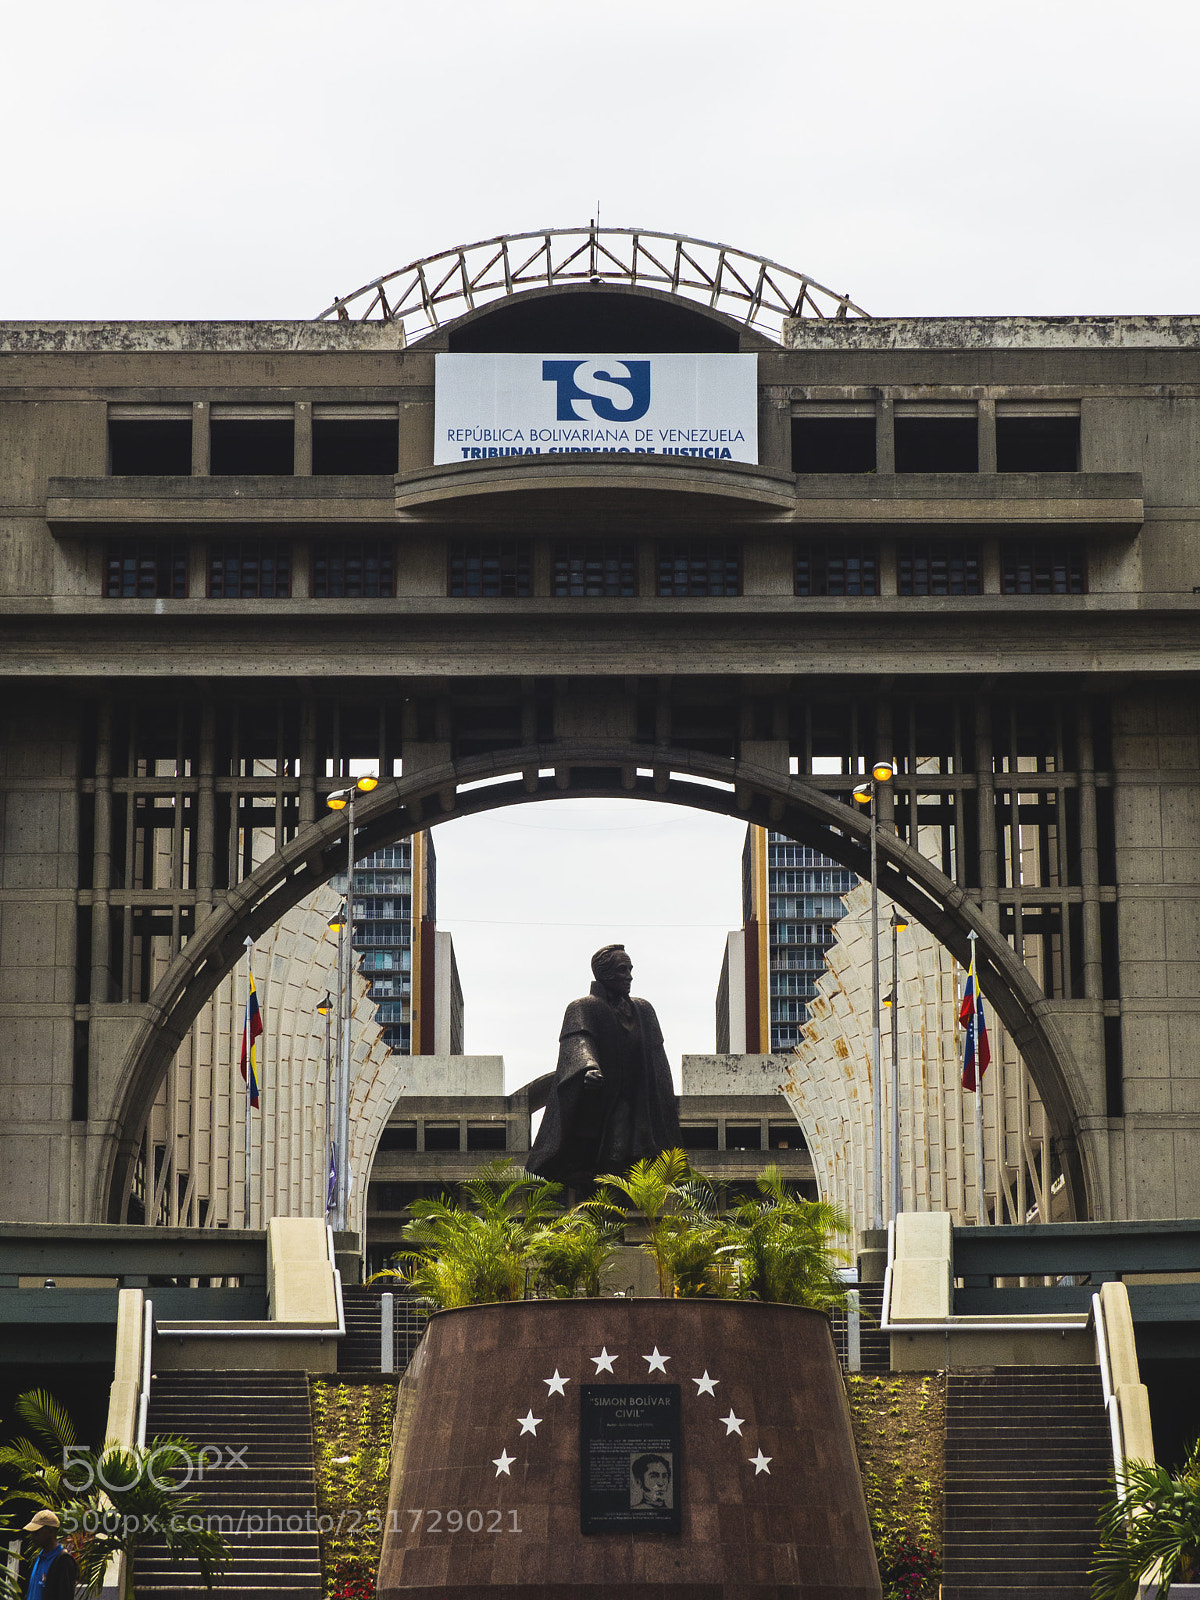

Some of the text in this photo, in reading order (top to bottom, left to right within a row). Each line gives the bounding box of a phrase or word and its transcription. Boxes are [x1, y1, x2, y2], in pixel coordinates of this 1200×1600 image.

[542, 360, 650, 422] TSJ
[447, 425, 745, 442] REPÚBLICA BOLIVARIANA DE VENEZUELA
